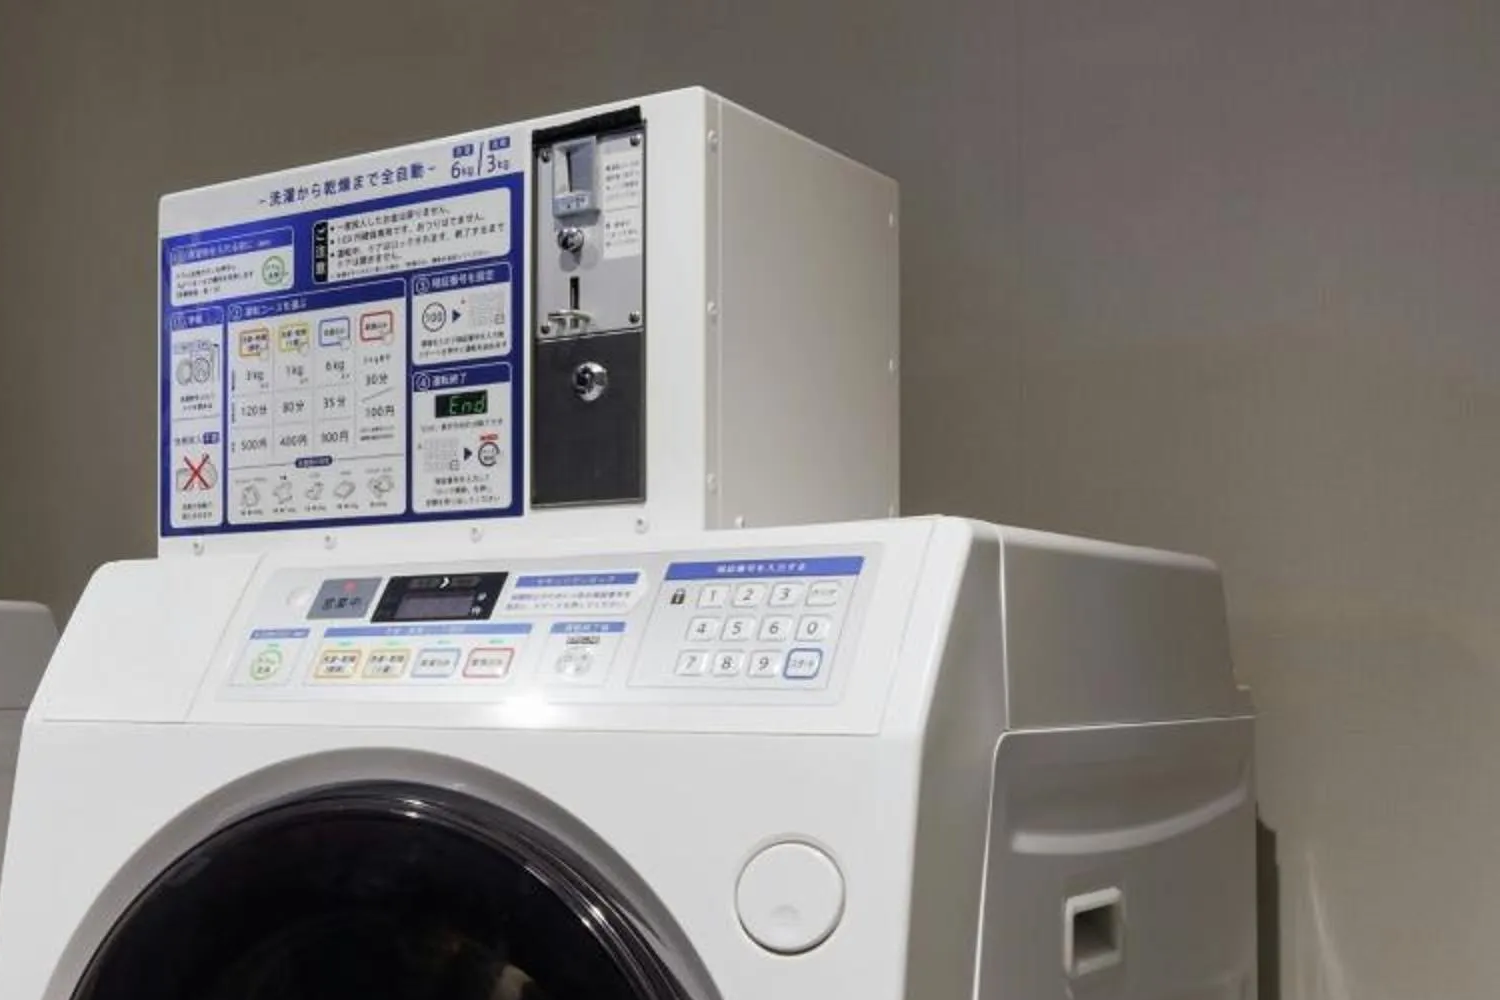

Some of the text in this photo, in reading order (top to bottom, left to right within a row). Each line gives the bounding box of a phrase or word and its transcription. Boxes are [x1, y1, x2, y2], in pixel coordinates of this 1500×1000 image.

[449, 395, 485, 416] End
[742, 588, 753, 601] 2
[780, 587, 790, 600] 3
[697, 621, 818, 635] 4 5 6 0
[685, 656, 697, 670] 7
[721, 656, 733, 670] 8
[759, 656, 770, 670] 9
